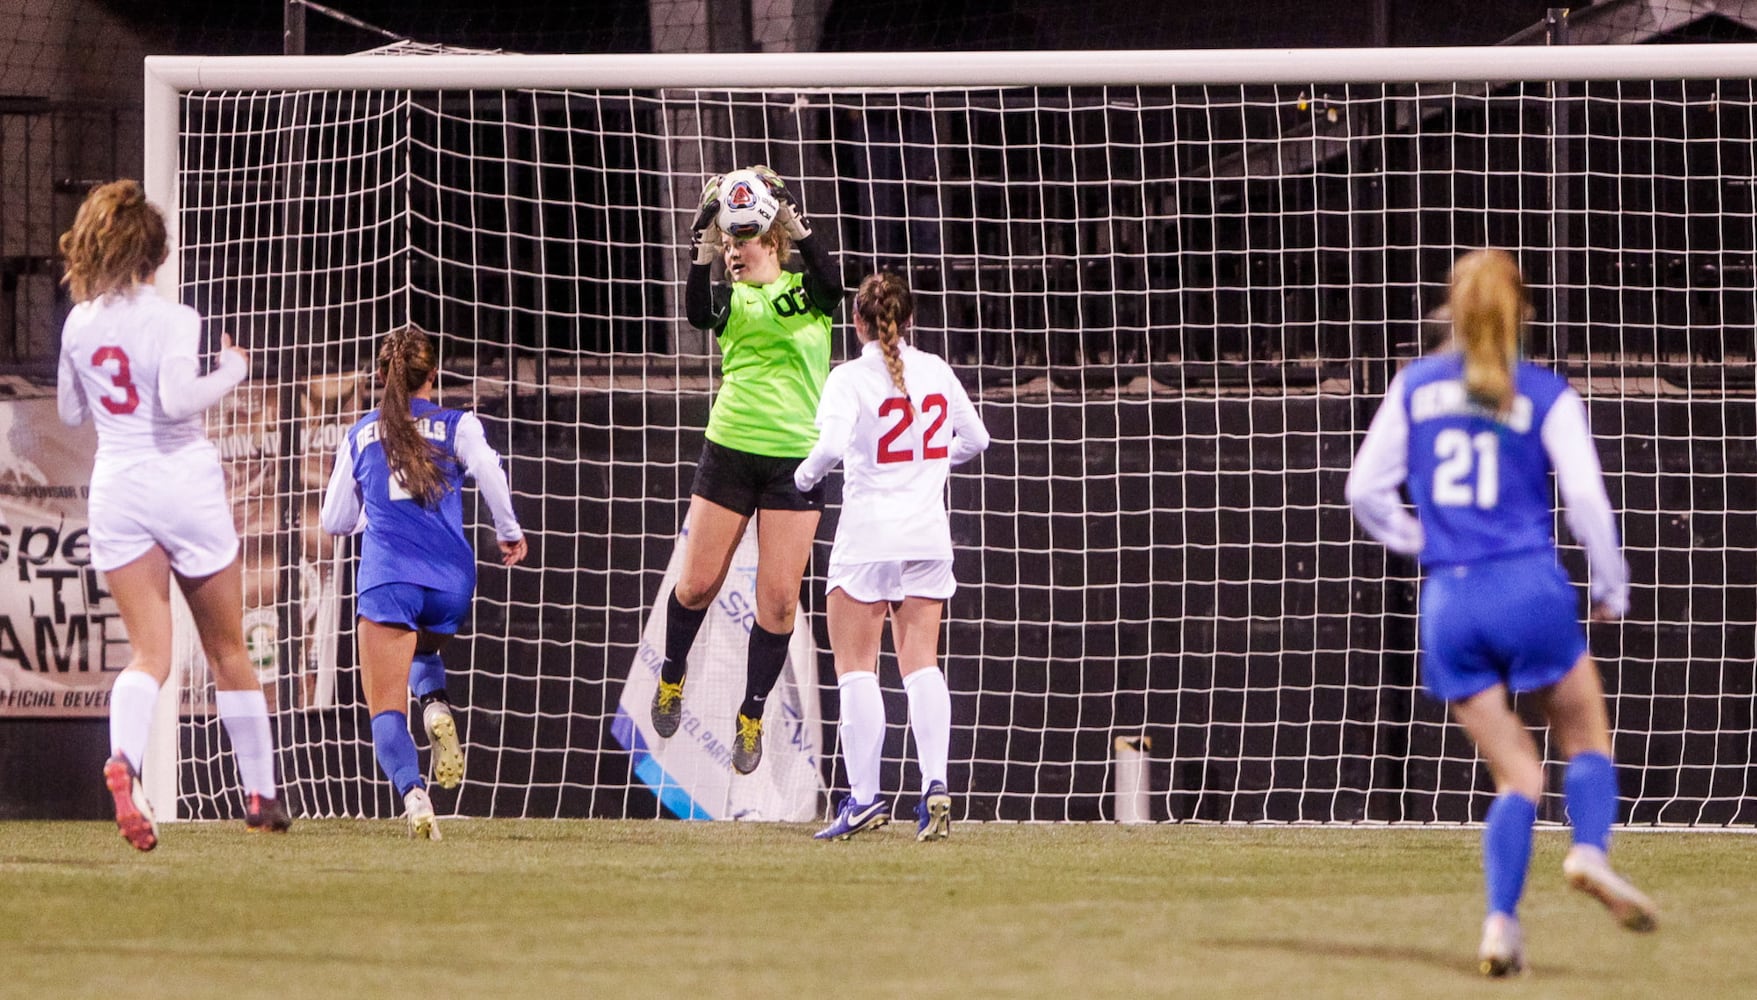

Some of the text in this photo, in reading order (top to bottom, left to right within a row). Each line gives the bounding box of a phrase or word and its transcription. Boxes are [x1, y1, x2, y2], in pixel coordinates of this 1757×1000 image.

[91, 346, 140, 415] 3
[877, 393, 948, 464] 22
[1432, 428, 1499, 509] 21
